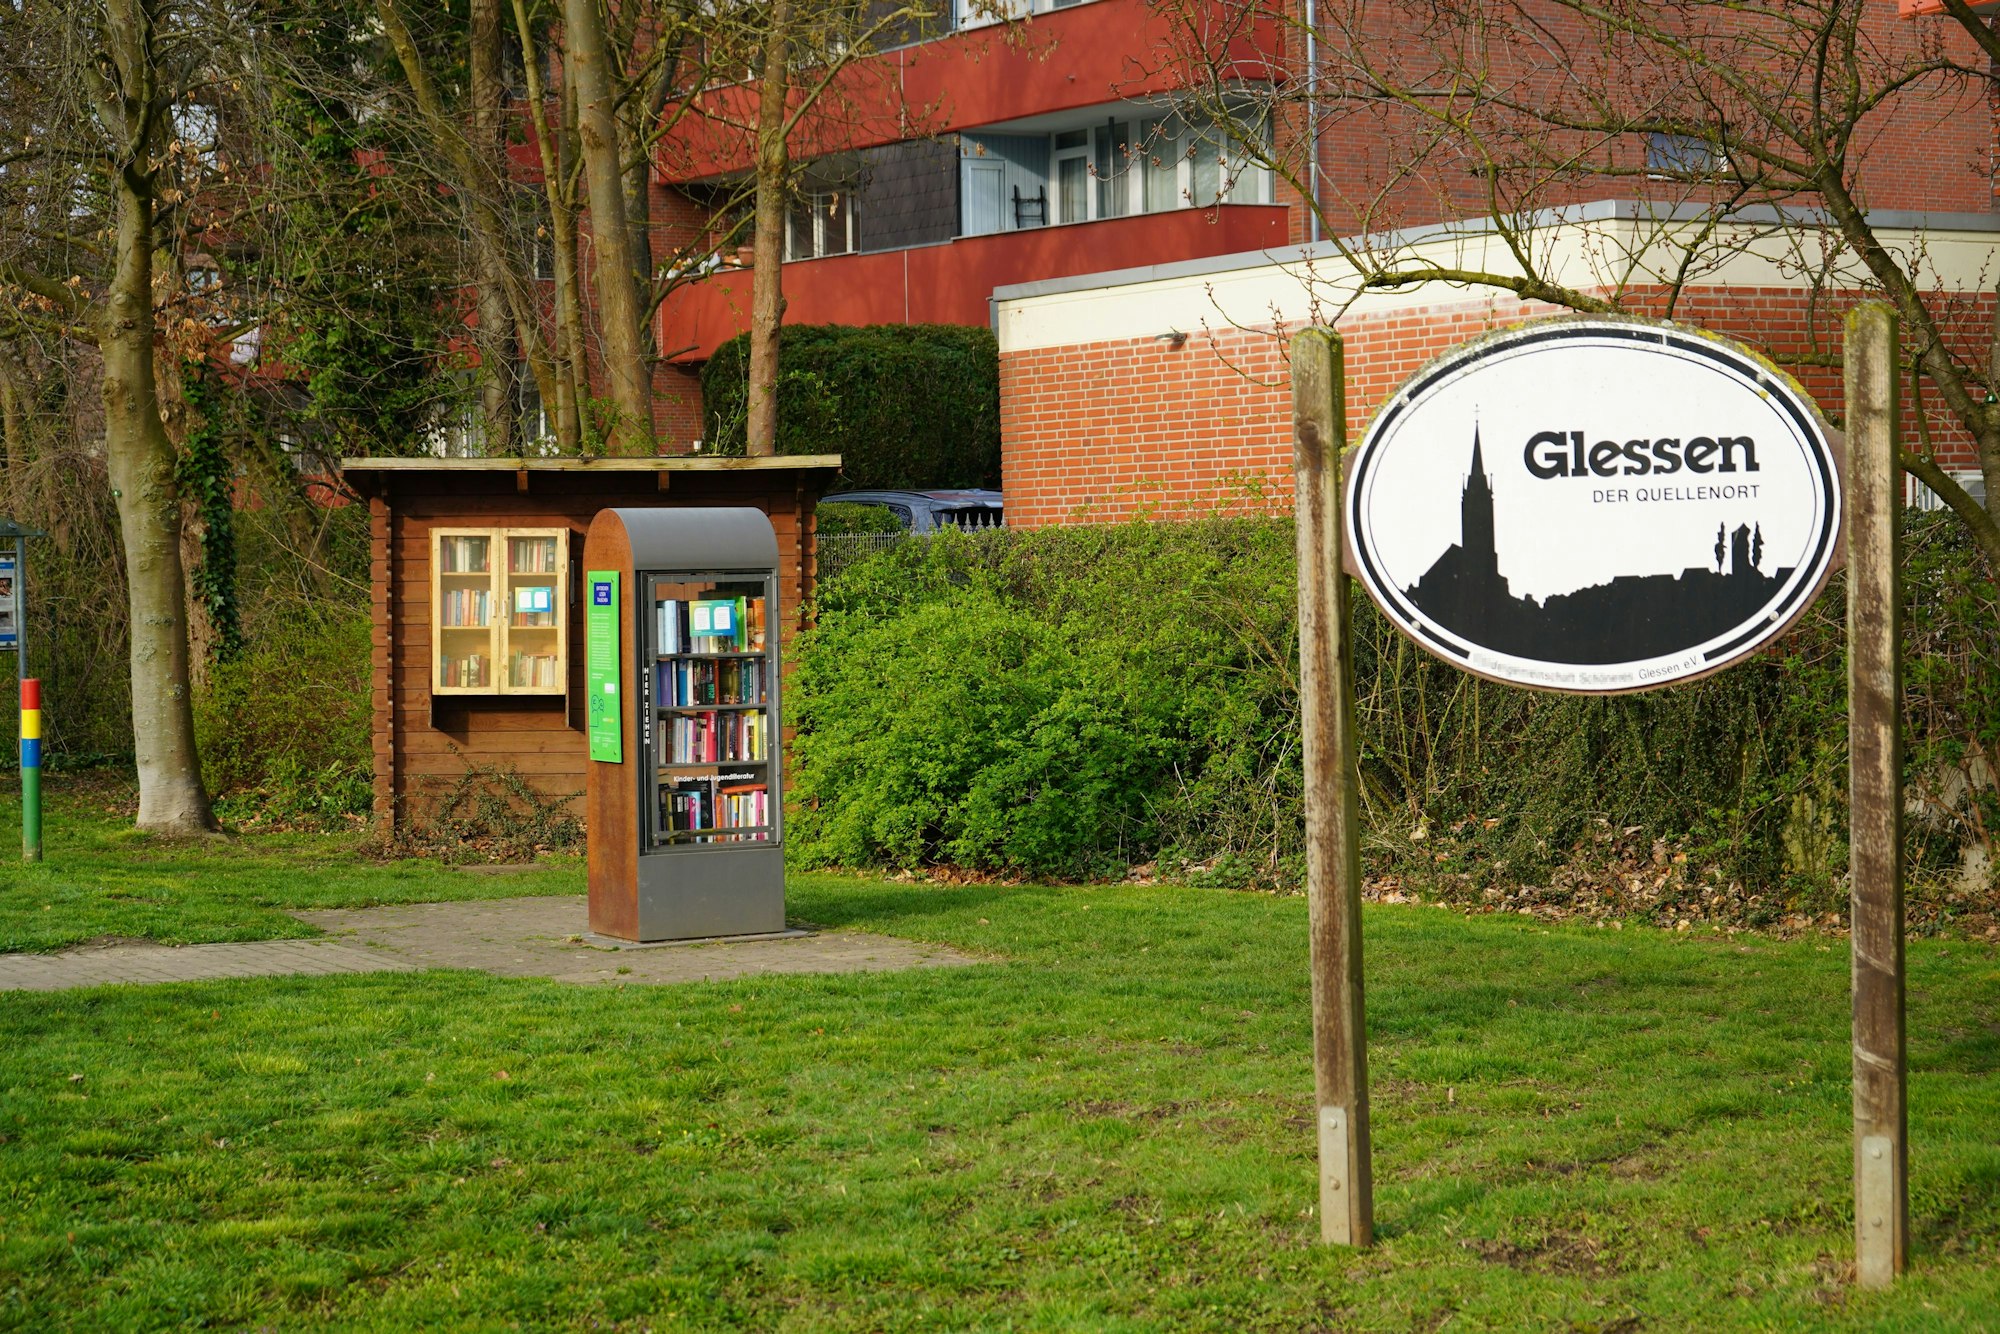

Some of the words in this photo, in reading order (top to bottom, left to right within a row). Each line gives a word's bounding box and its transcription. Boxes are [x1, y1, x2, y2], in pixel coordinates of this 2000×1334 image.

[1523, 431, 1760, 480] Glessen
[1593, 489, 1629, 503] DER
[1636, 485, 1760, 501] QUELLENORT
[1638, 664, 1680, 680] Glessen
[709, 773, 755, 782] Jugendliteratur
